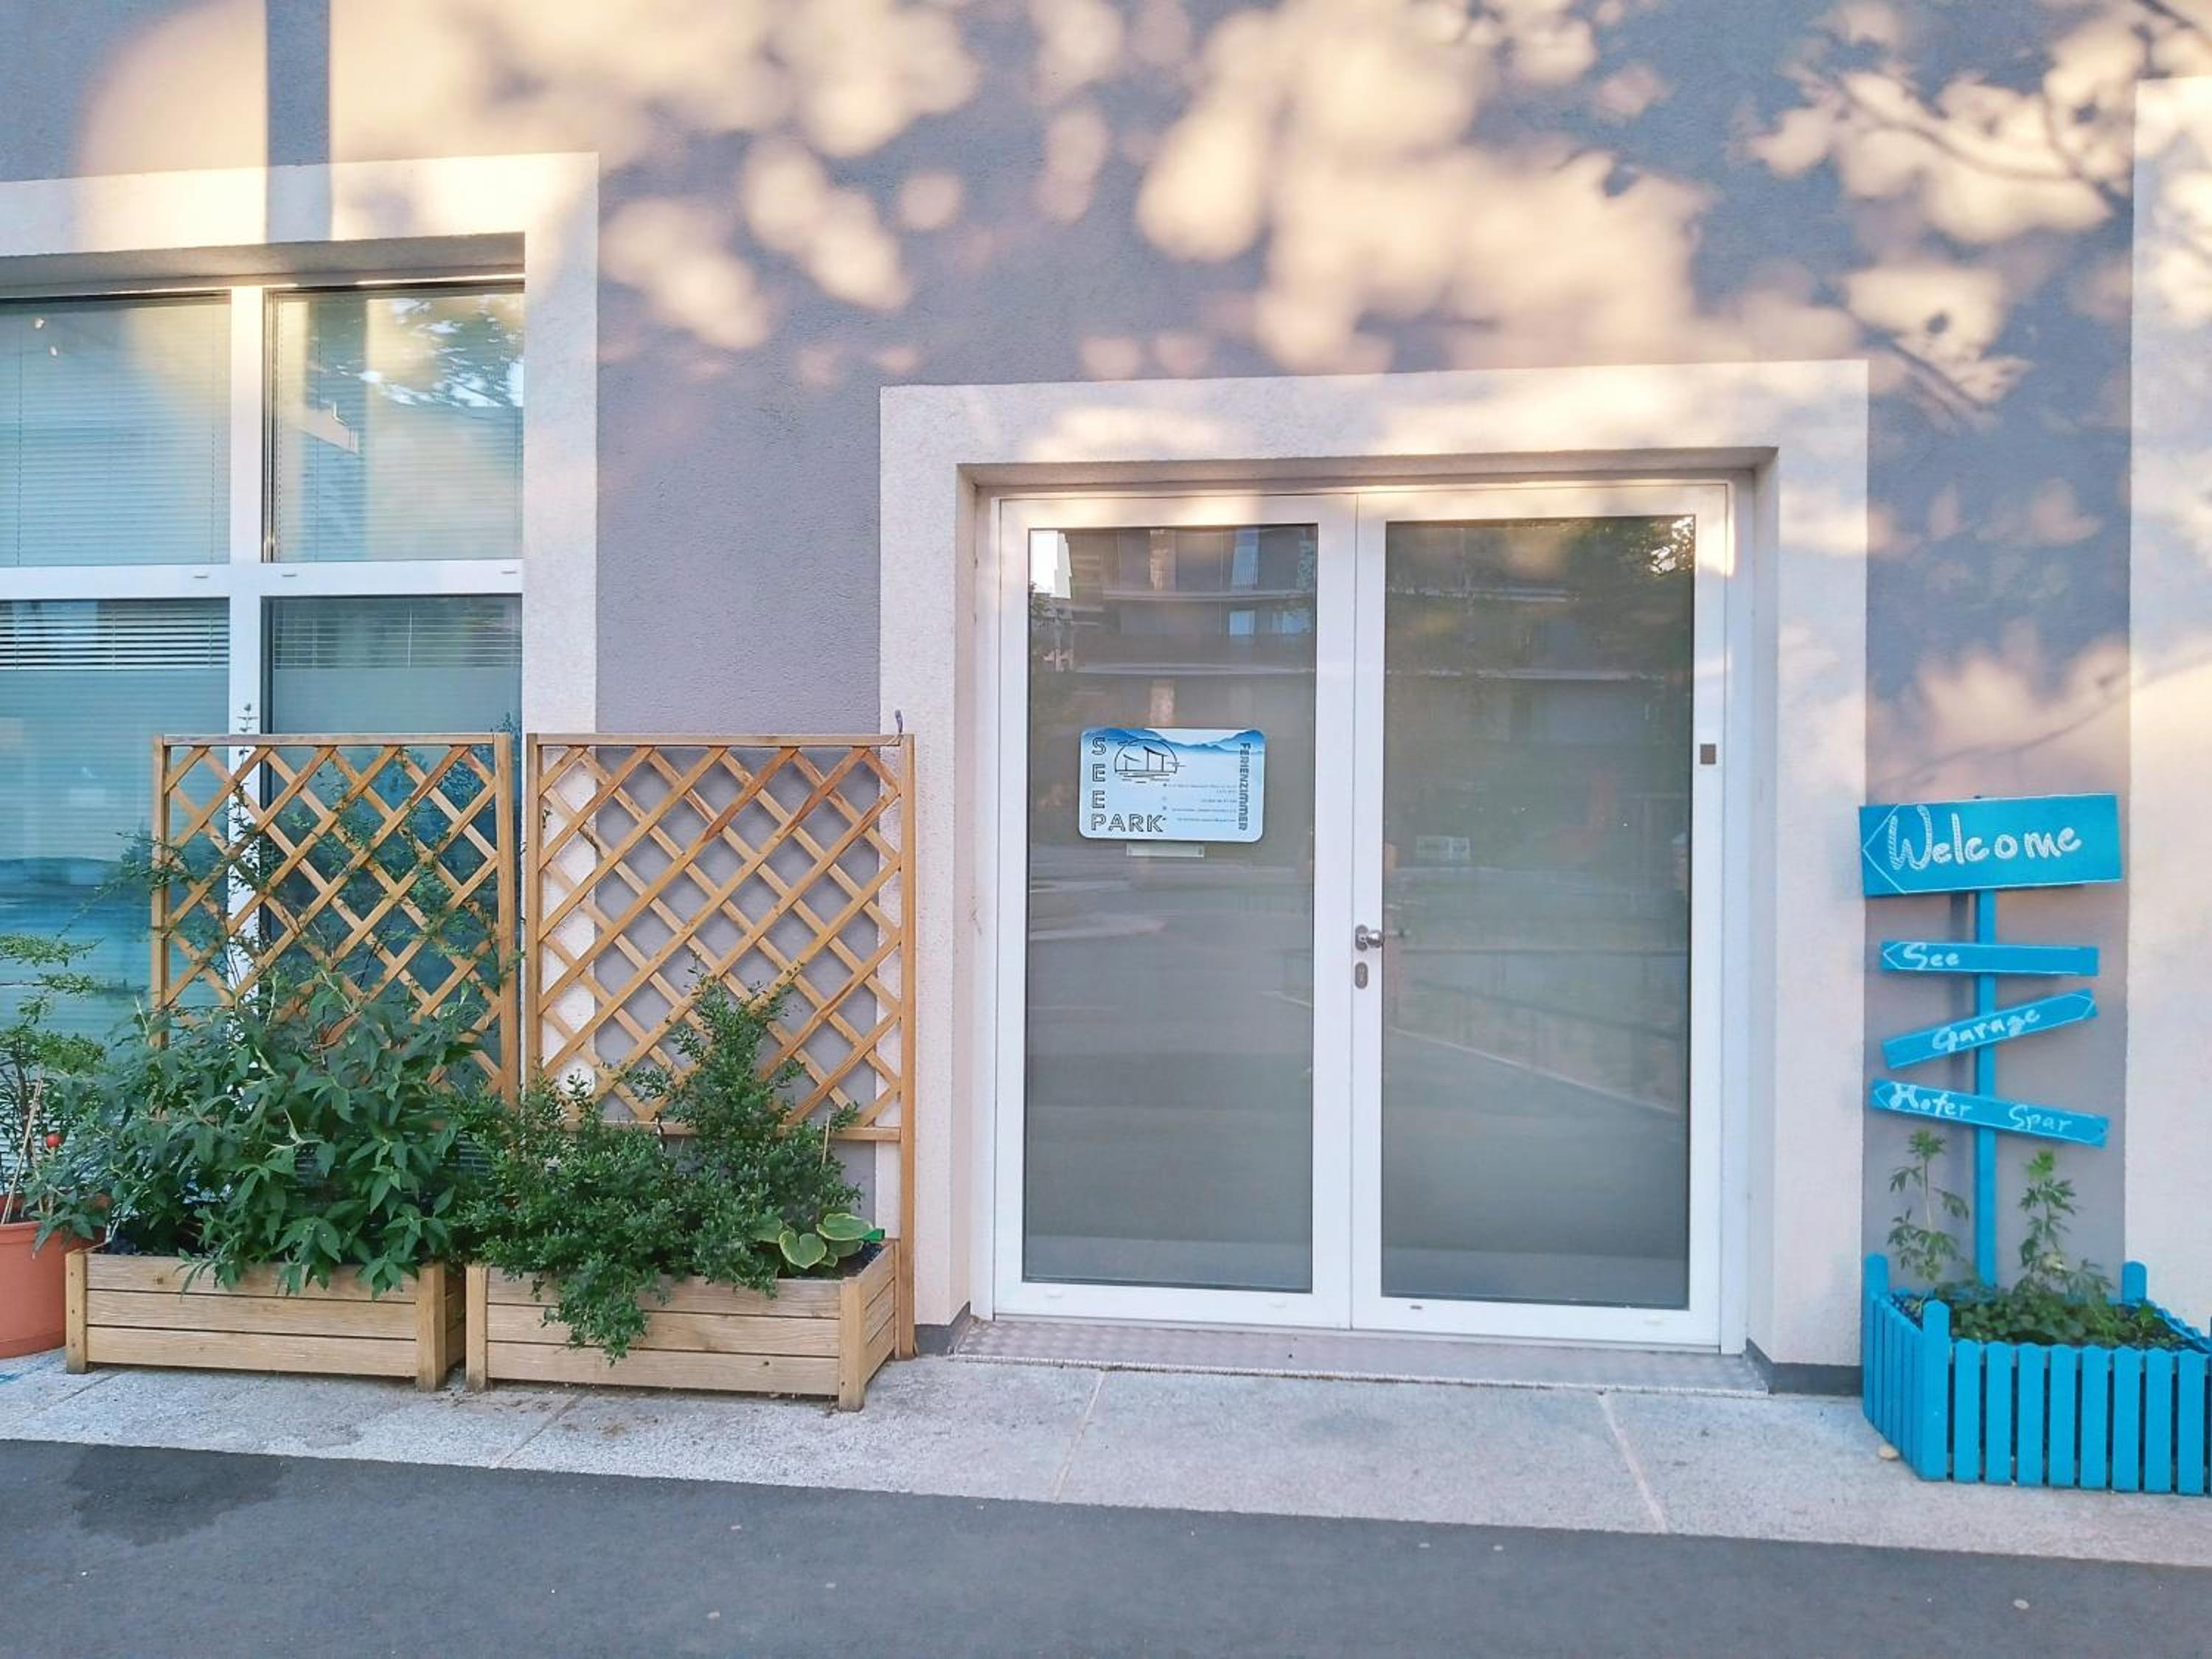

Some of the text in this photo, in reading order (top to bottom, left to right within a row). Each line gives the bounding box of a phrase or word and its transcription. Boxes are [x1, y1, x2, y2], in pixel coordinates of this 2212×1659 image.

[1239, 742, 1251, 831] FERIENZIMMER
[1091, 813, 1164, 832] PARK
[1887, 804, 2081, 870] Welcome
[1902, 942, 1959, 970] See
[1932, 1009, 2041, 1052] Garage
[1889, 1082, 2072, 1131] Hofer Spar
